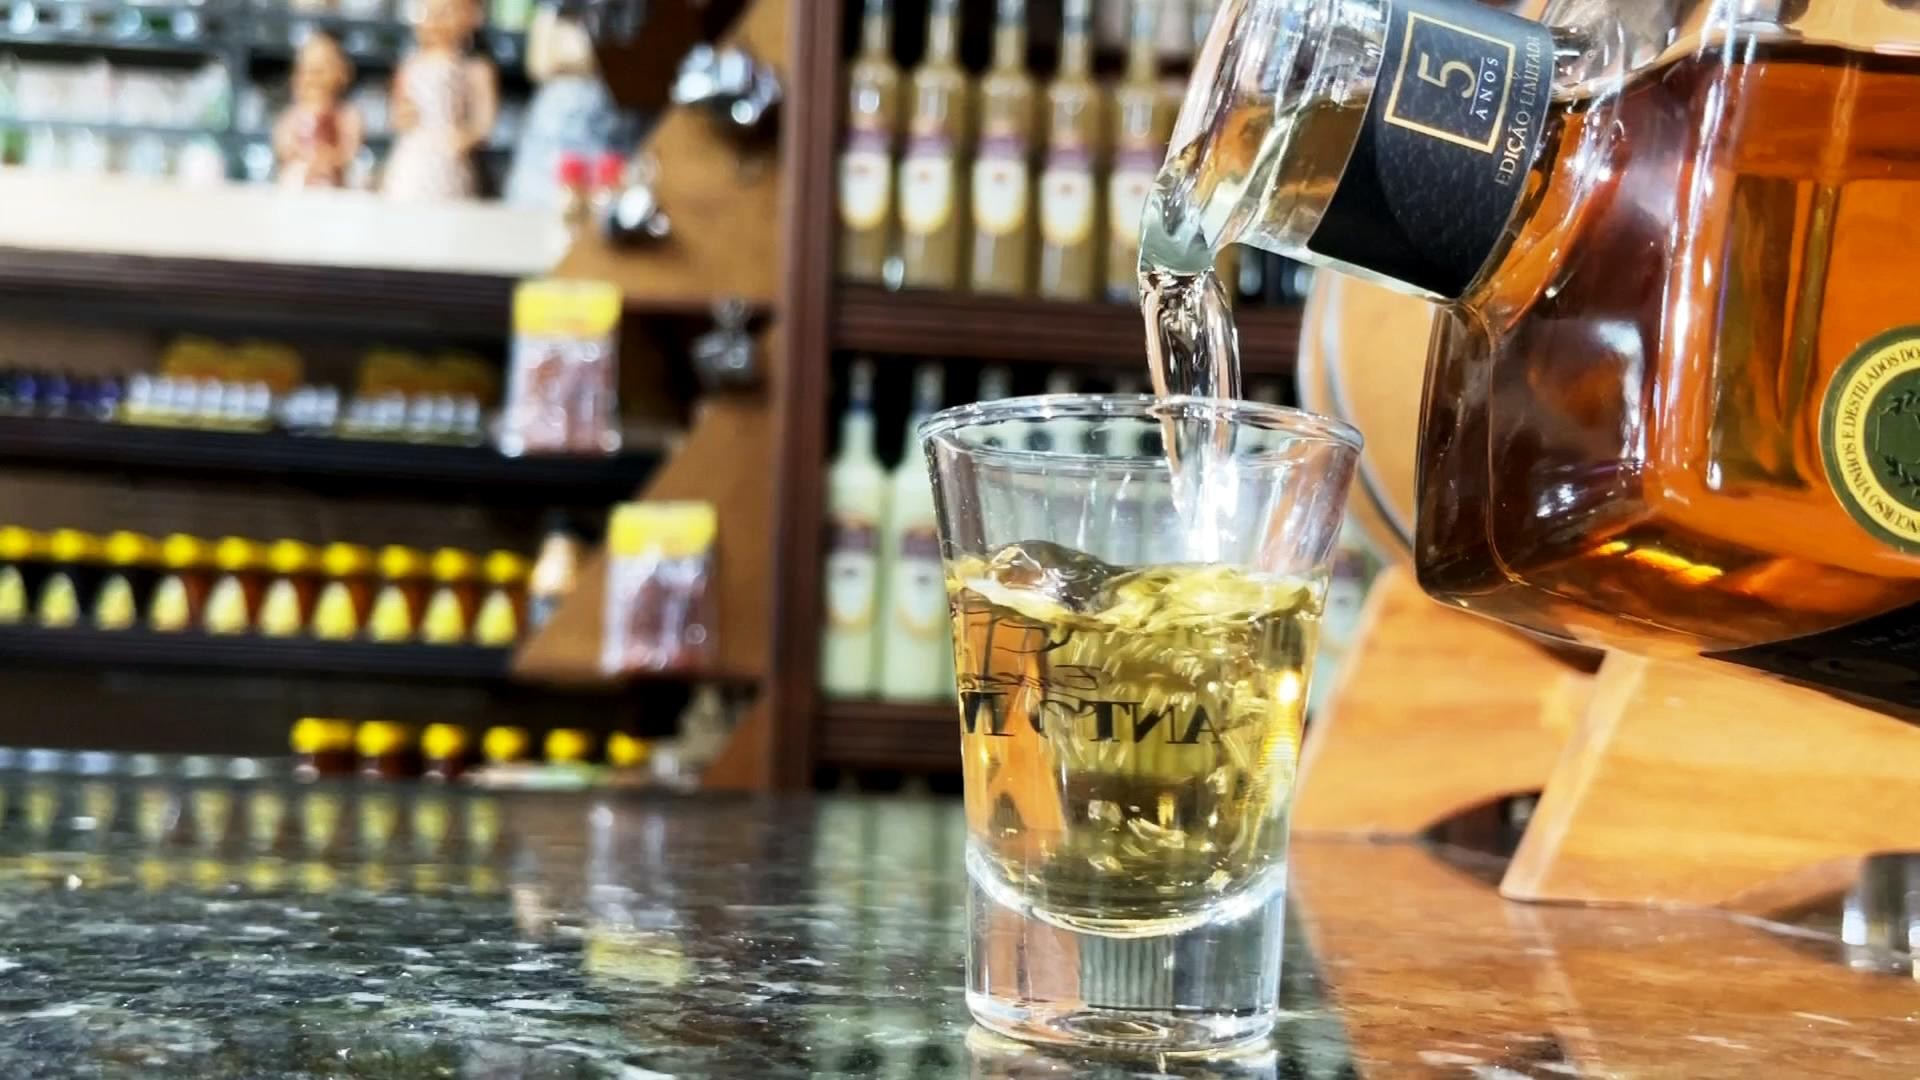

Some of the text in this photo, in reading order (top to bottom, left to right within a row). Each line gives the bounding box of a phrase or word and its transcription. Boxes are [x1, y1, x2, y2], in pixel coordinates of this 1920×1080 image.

[1417, 52, 1476, 98] 5
[1475, 57, 1499, 120] ANOS
[1494, 110, 1531, 186] EDIÇÃO
[1842, 352, 1900, 428] DESTILADOS
[1842, 430, 1856, 439] E
[1844, 442, 1872, 498] VINHOS
